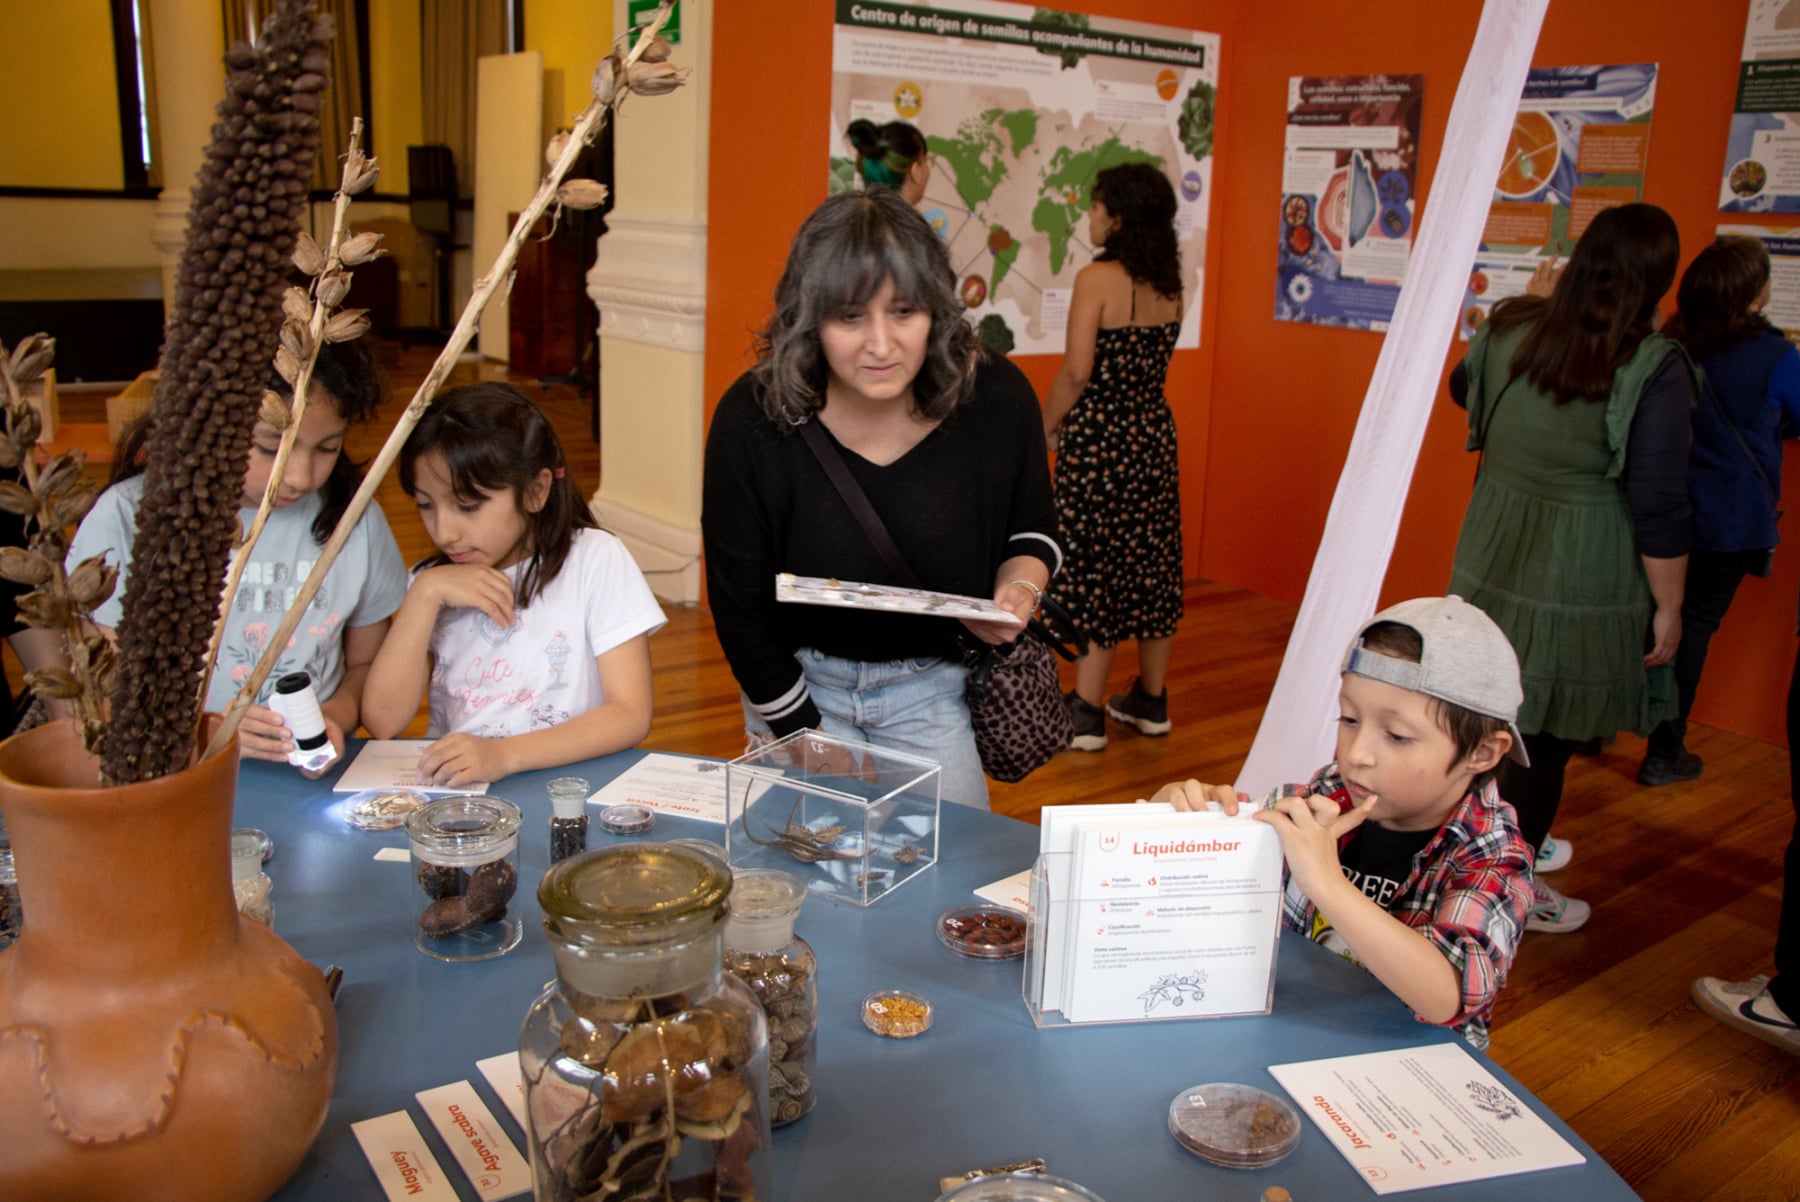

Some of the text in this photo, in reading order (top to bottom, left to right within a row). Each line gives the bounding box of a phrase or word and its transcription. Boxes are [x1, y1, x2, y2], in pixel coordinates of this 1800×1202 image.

[850, 4, 1201, 63] Centro de origen de semillas acompañantes de la humanidad
[464, 656, 513, 690] Cute
[1132, 838, 1242, 858] Liquidámbar
[448, 1104, 478, 1138] scabra
[1313, 1095, 1372, 1150] Jacaranda
[472, 1138, 502, 1172] Agave
[390, 1150, 424, 1196] Maguey
